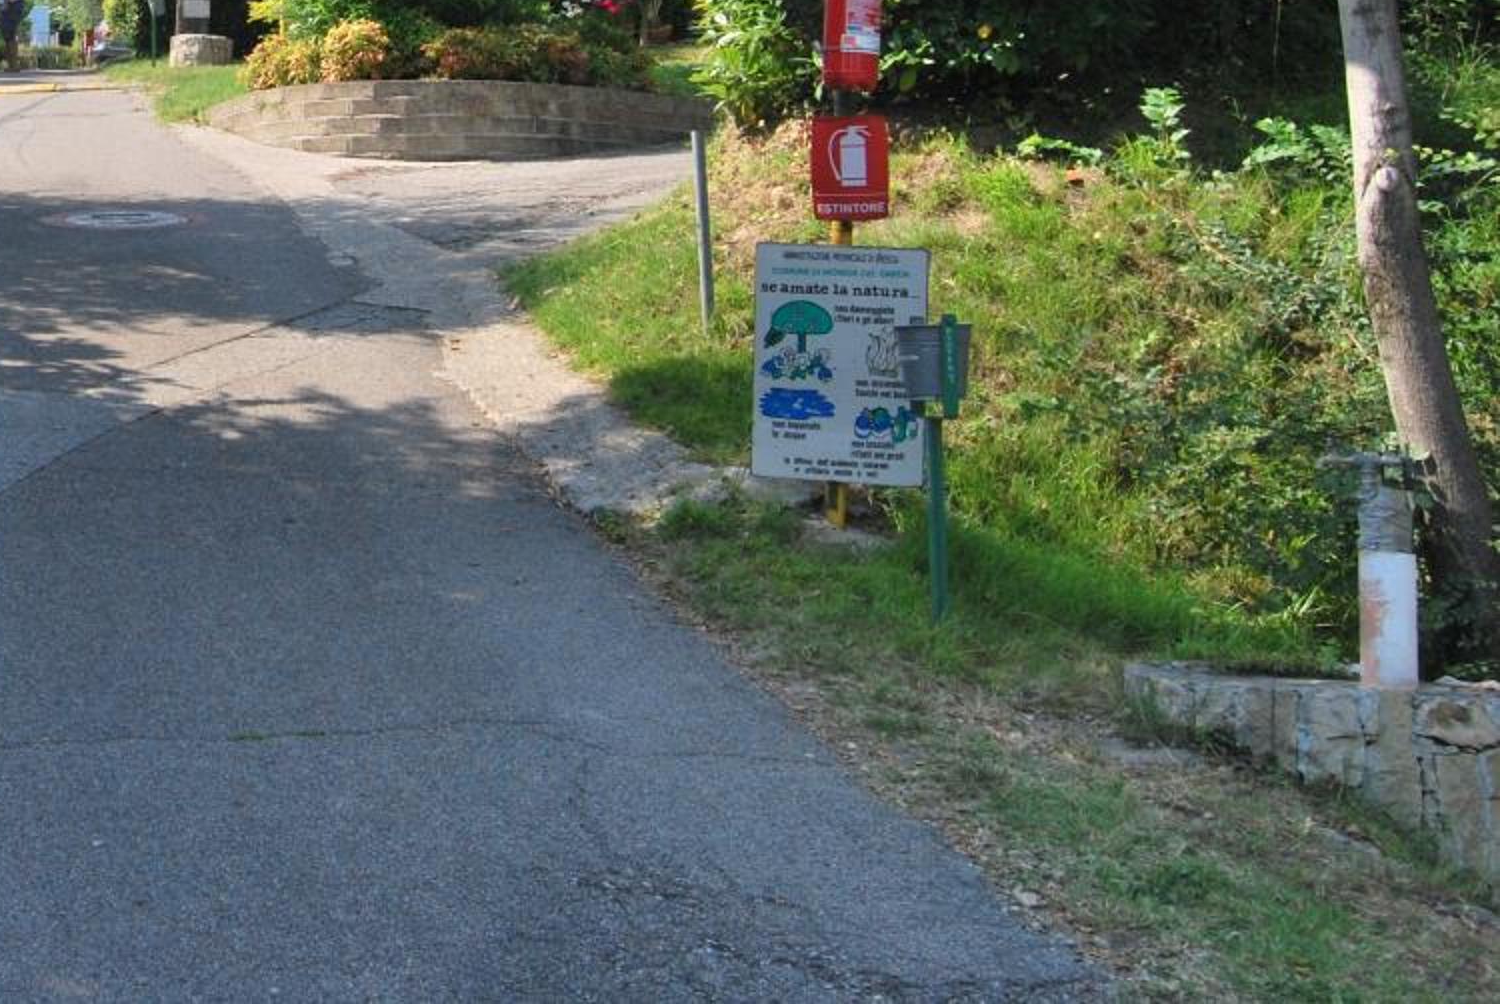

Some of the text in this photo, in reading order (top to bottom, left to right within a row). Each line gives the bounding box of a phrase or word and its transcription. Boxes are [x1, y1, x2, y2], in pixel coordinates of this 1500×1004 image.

[816, 202, 884, 214] ESTINTORE
[761, 283, 777, 293] se
[780, 283, 829, 296] amate
[833, 283, 848, 295] la
